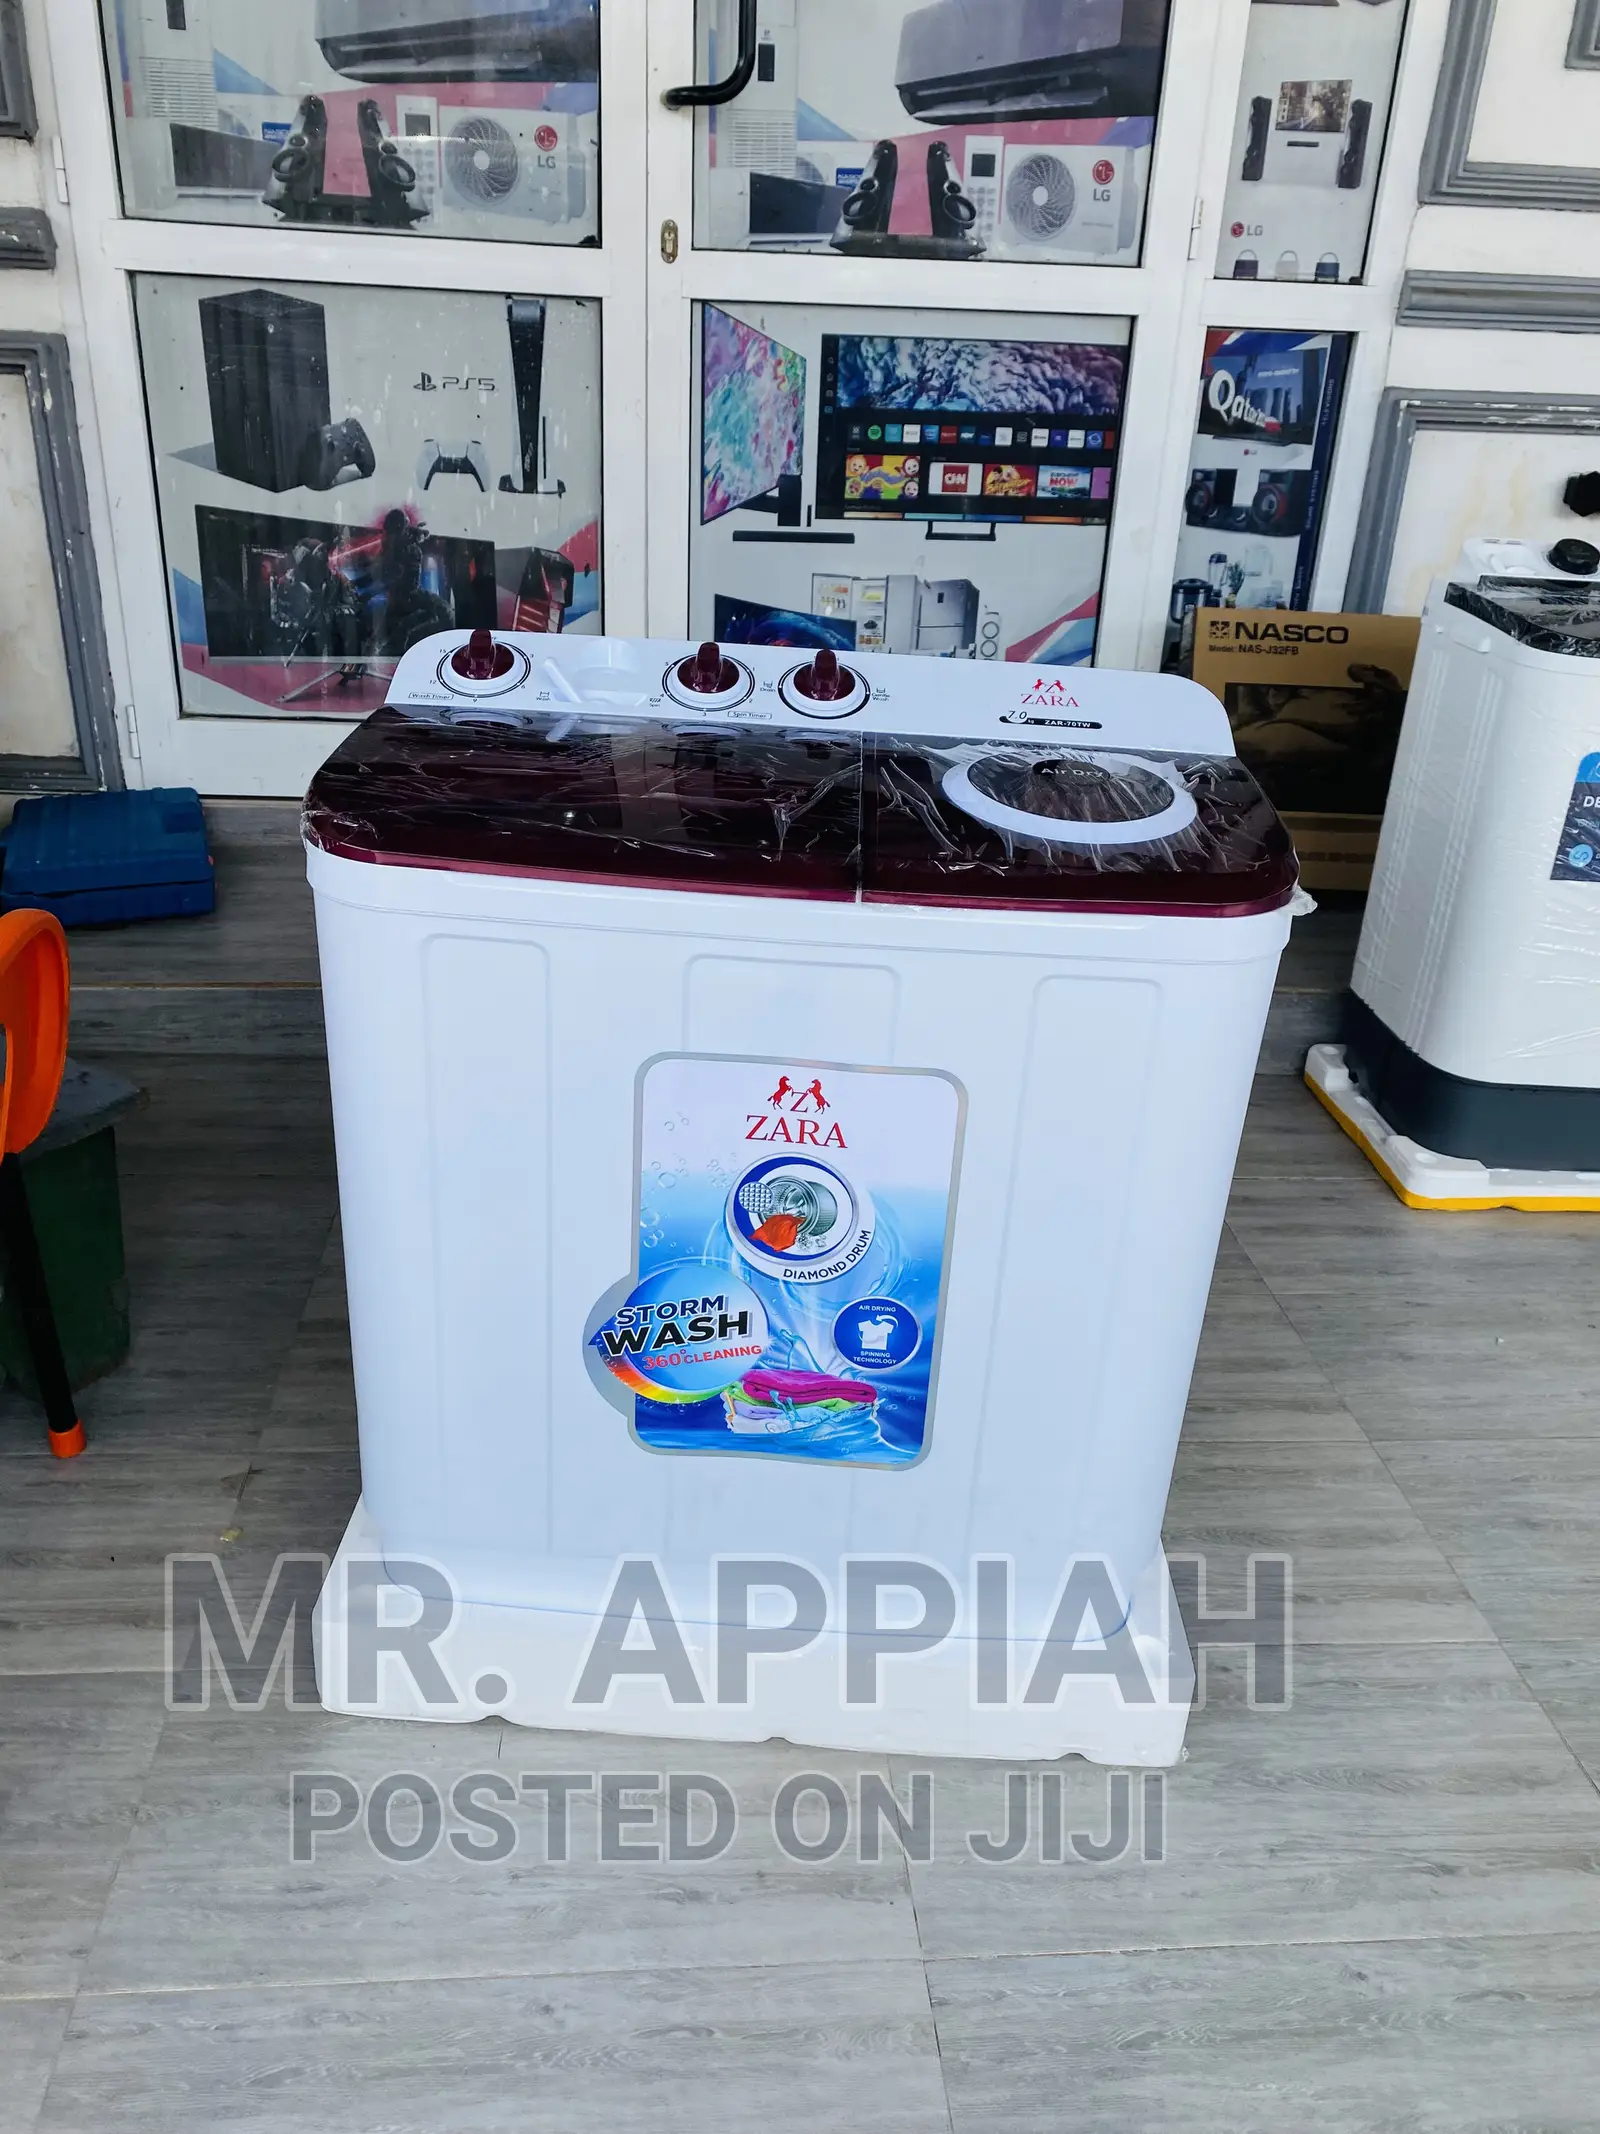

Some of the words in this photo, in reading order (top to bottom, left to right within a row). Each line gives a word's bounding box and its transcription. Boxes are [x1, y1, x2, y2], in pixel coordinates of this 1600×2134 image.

[537, 155, 556, 169] LG
[1093, 188, 1111, 202] LG
[442, 376, 496, 391] PS5
[1235, 621, 1349, 644] NASCO
[1238, 644, 1300, 656] NAS-J32FB
[1020, 693, 1080, 708] ZARA
[1007, 710, 1028, 720] 7.0
[1044, 719, 1091, 728] ZAR-70TW
[1041, 768, 1067, 776] Air
[1072, 769, 1104, 778] Dry
[745, 1114, 849, 1149] ZARA
[783, 1261, 847, 1280] DIAMOND
[845, 1229, 872, 1263] DRUM
[616, 1294, 726, 1326] STORM
[601, 1310, 750, 1358] WASH
[683, 1345, 763, 1364] CLEANING
[853, 1356, 898, 1365] TECHNOLOGY
[860, 1350, 891, 1358] SPINNING
